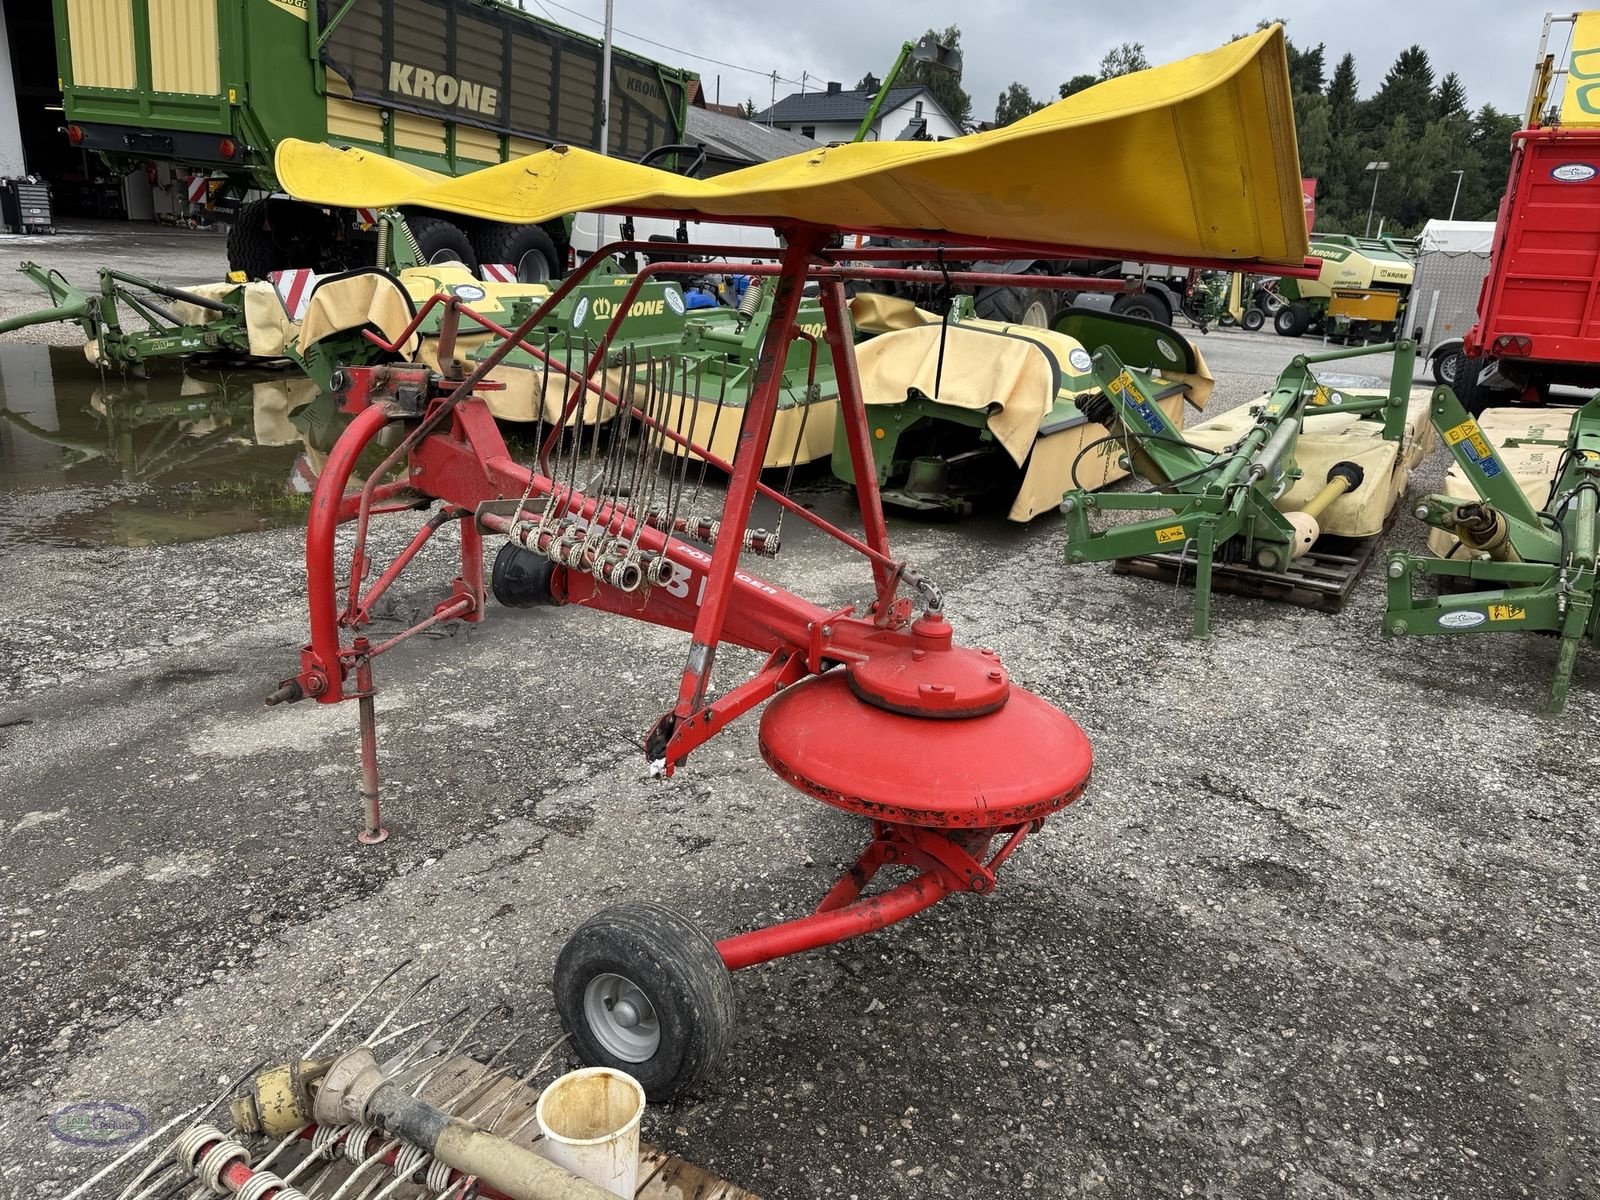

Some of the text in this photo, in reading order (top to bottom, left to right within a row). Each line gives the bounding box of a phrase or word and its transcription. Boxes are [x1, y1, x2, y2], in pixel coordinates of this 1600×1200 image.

[388, 61, 498, 115] KRONE
[1312, 248, 1344, 259] KRONE
[1386, 271, 1408, 279] KRONE
[611, 301, 665, 318] KONE
